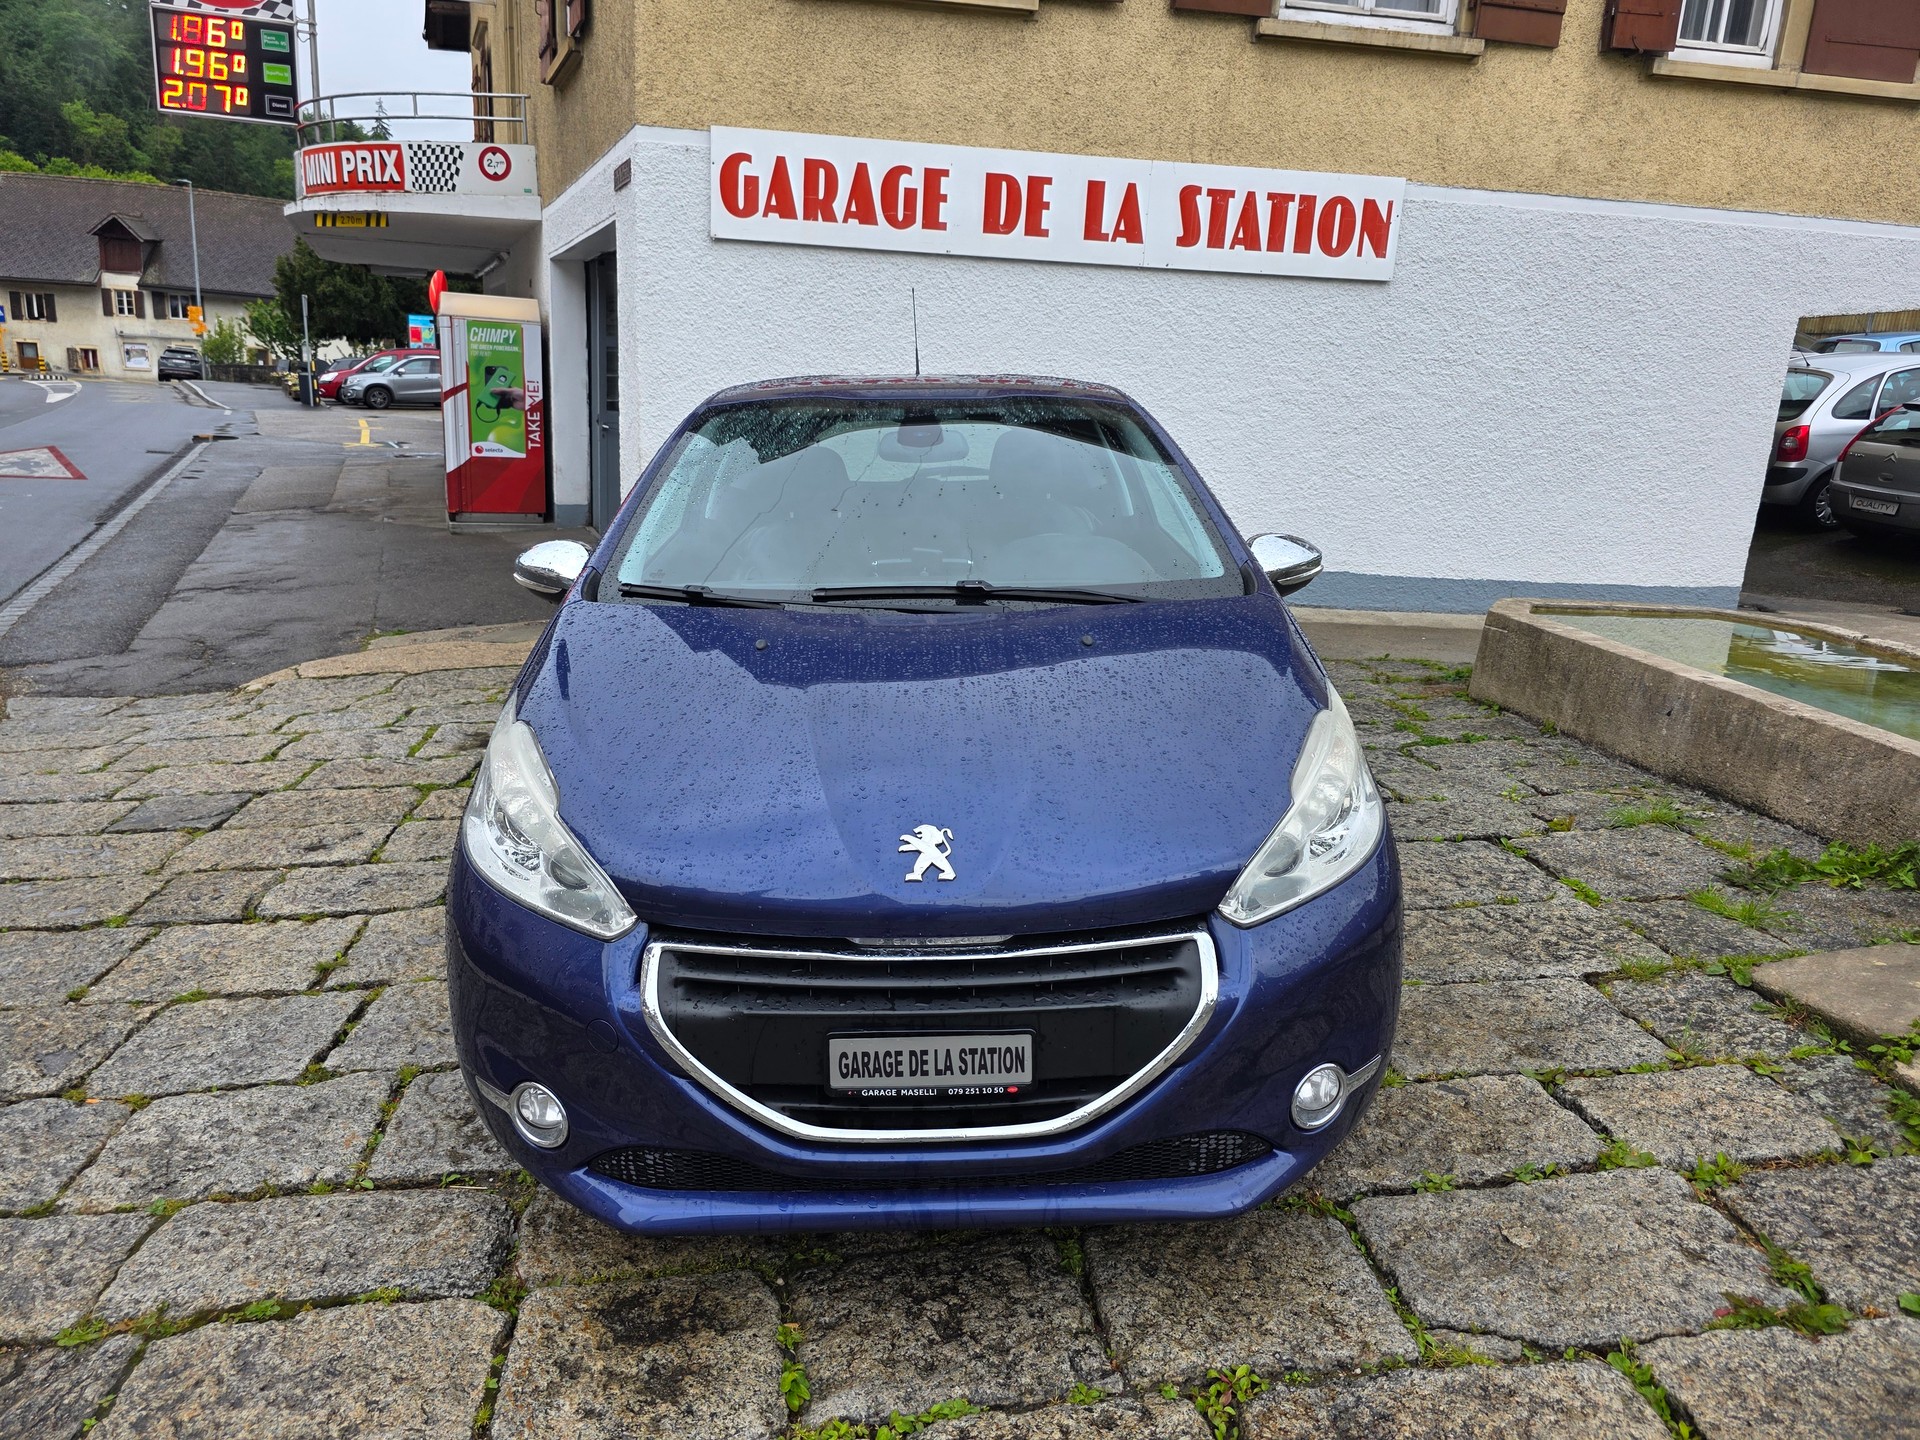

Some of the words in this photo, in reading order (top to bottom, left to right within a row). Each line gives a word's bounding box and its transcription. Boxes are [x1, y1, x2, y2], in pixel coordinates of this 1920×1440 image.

[304, 151, 337, 187] MINI
[341, 149, 402, 184] PRIX
[719, 152, 950, 231] GARAGE
[982, 172, 1053, 238] DE
[1083, 179, 1144, 245] LA
[1176, 184, 1394, 259] STATION
[470, 327, 517, 344] CHIMPY
[527, 411, 541, 450] TAKE
[838, 1050, 904, 1079] GARAGE
[908, 1049, 930, 1077] DE
[934, 1048, 954, 1076] LA
[958, 1046, 1026, 1075] STATION
[993, 1086, 1005, 1094] 50
